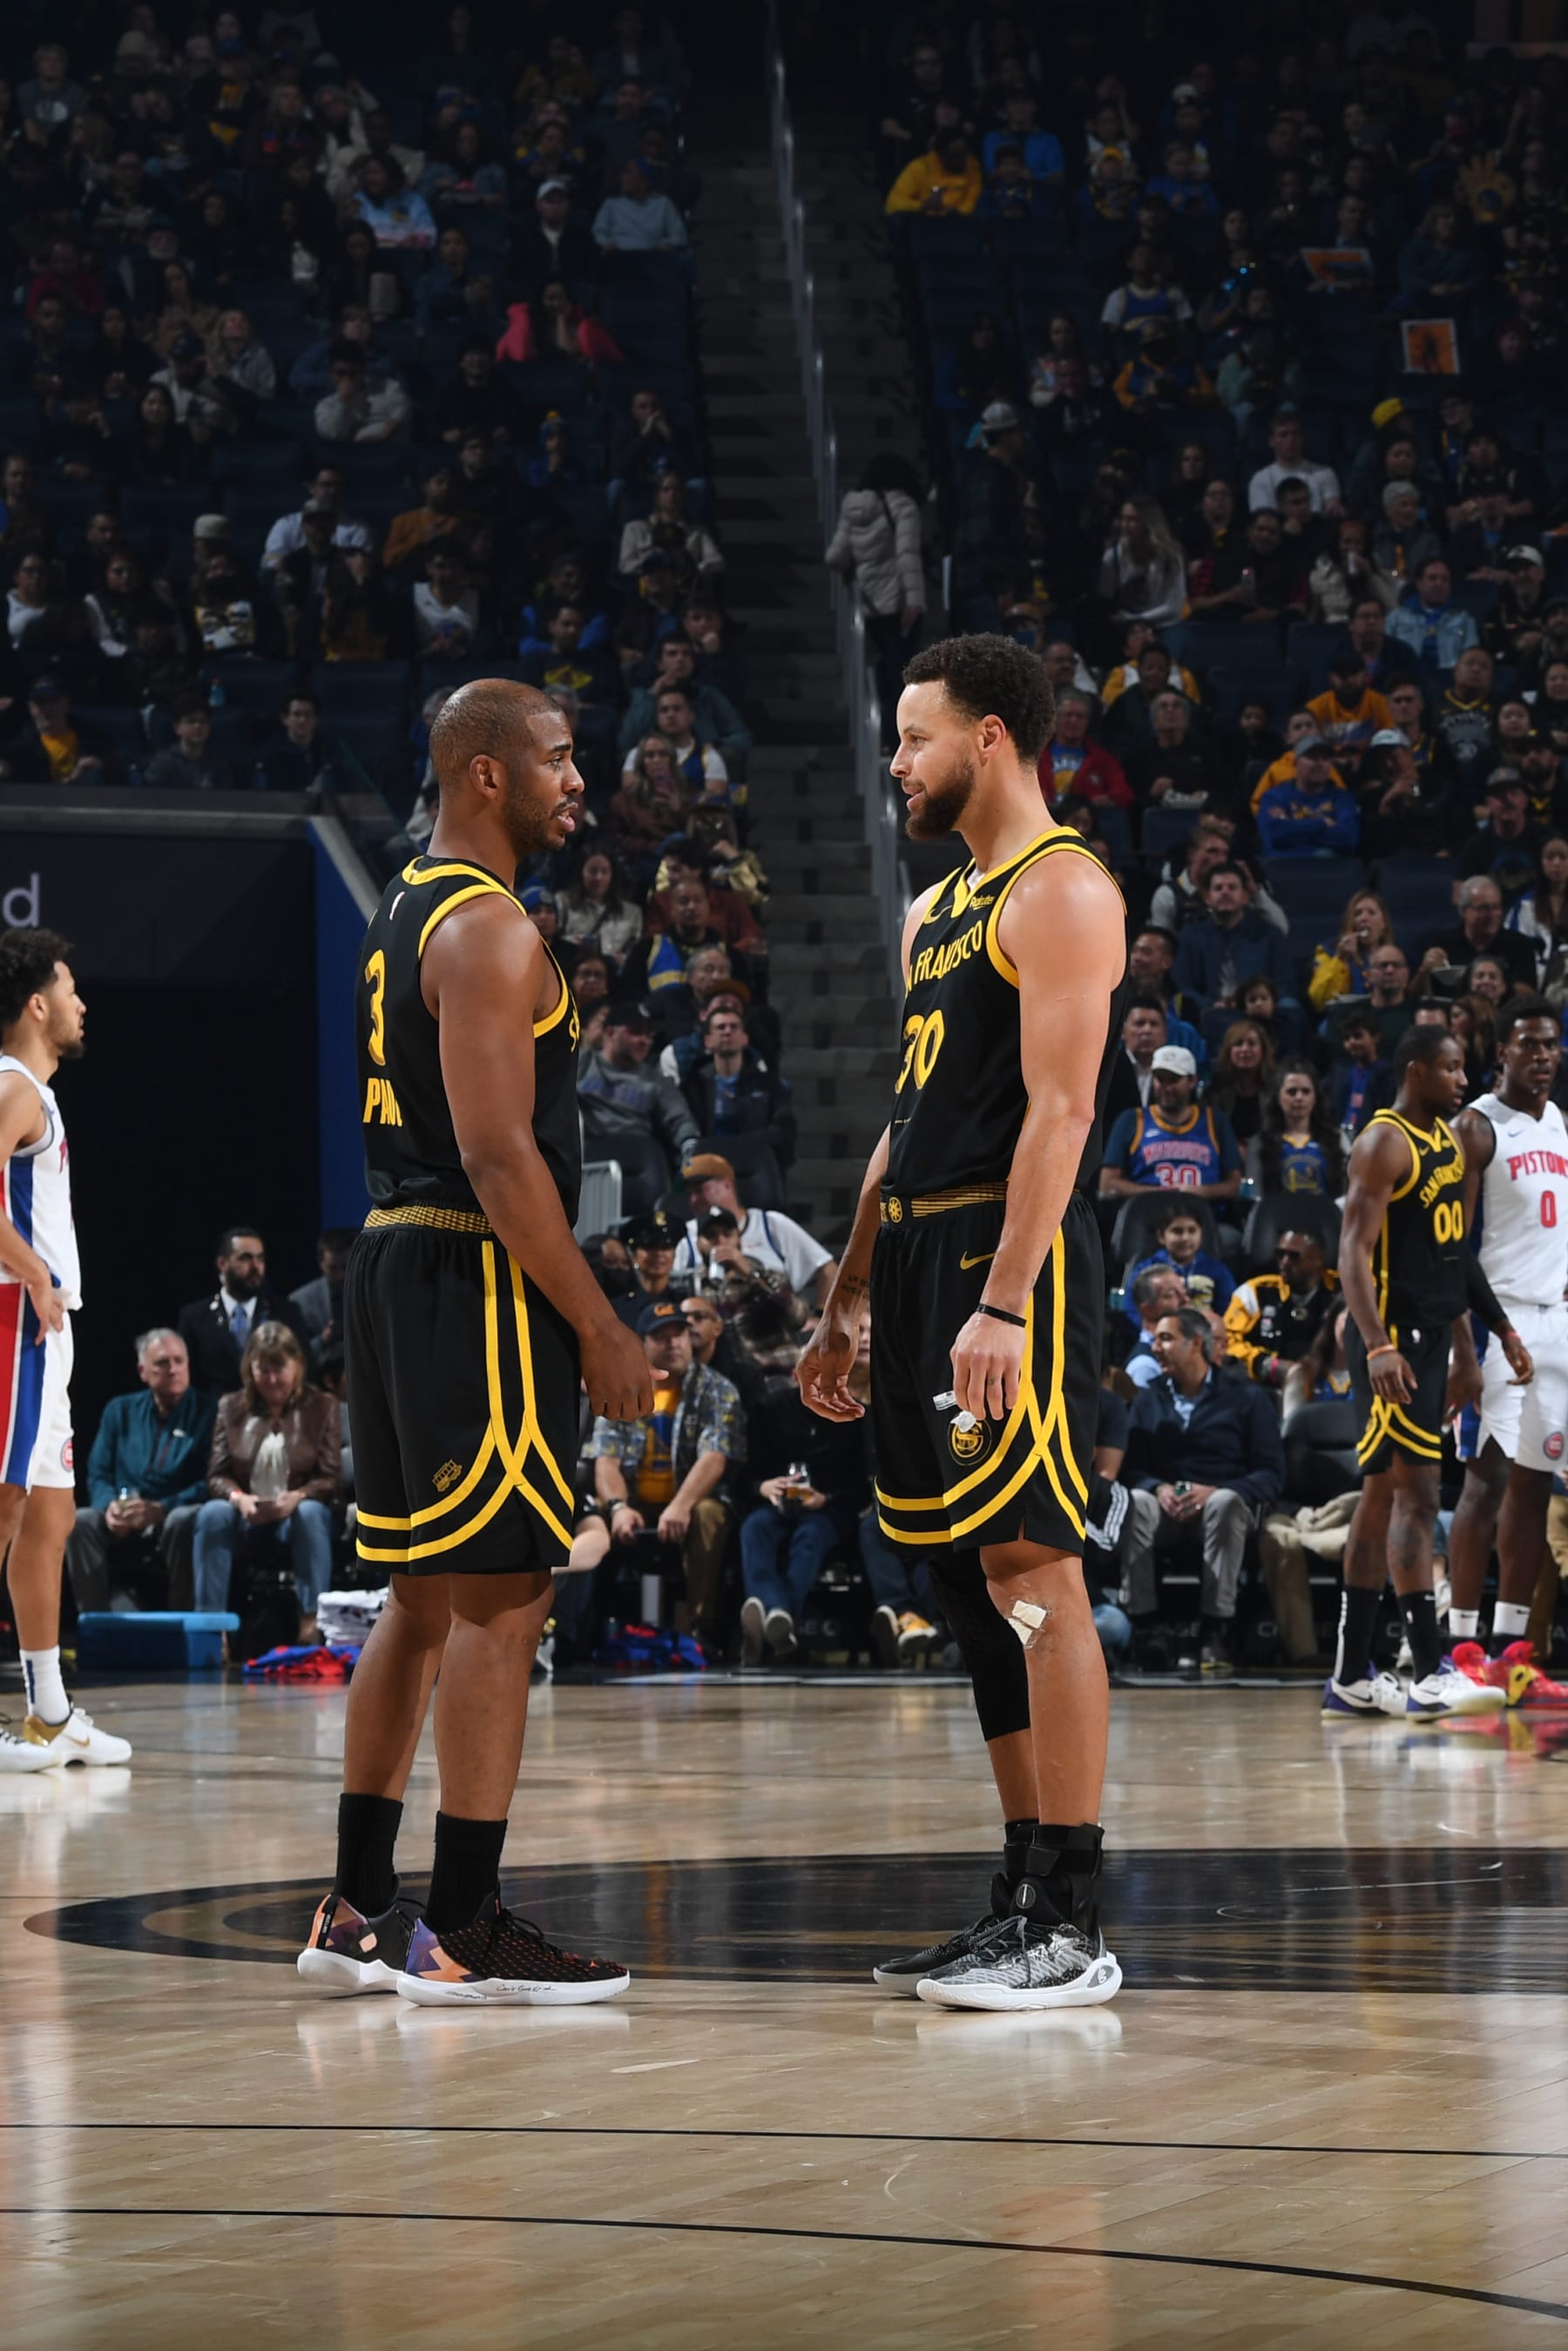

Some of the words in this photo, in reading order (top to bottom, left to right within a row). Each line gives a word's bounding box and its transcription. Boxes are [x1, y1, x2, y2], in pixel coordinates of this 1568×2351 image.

[364, 949, 386, 1066] 3
[895, 1009, 945, 1095] 30
[1155, 1161, 1202, 1191] 30
[1506, 1150, 1568, 1181] PISTON
[1434, 1199, 1463, 1244] 00
[1540, 1190, 1557, 1228] 0
